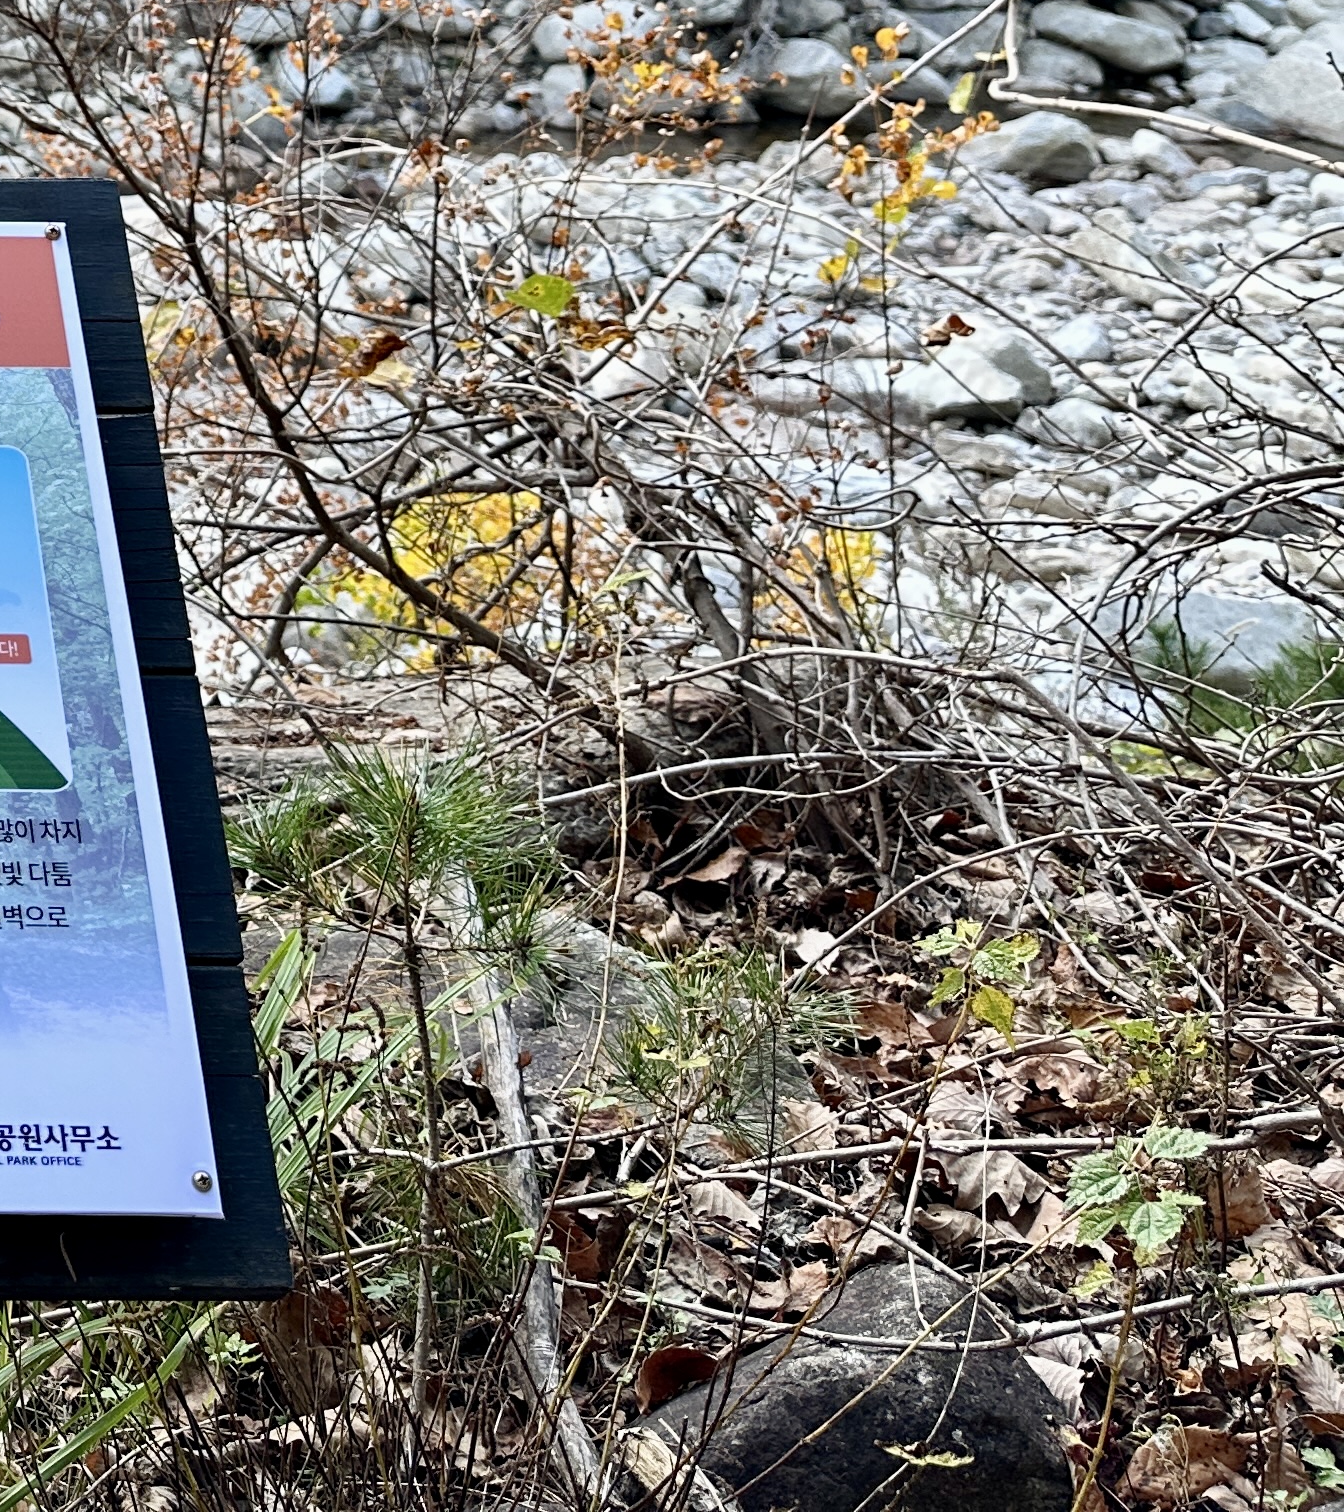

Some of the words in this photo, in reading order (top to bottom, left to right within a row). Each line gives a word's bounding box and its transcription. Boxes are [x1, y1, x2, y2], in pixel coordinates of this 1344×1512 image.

[40, 819, 82, 843] 차지
[29, 861, 72, 886] 다툼
[7, 1156, 37, 1166] PARK
[41, 1156, 82, 1166] OFFICE
